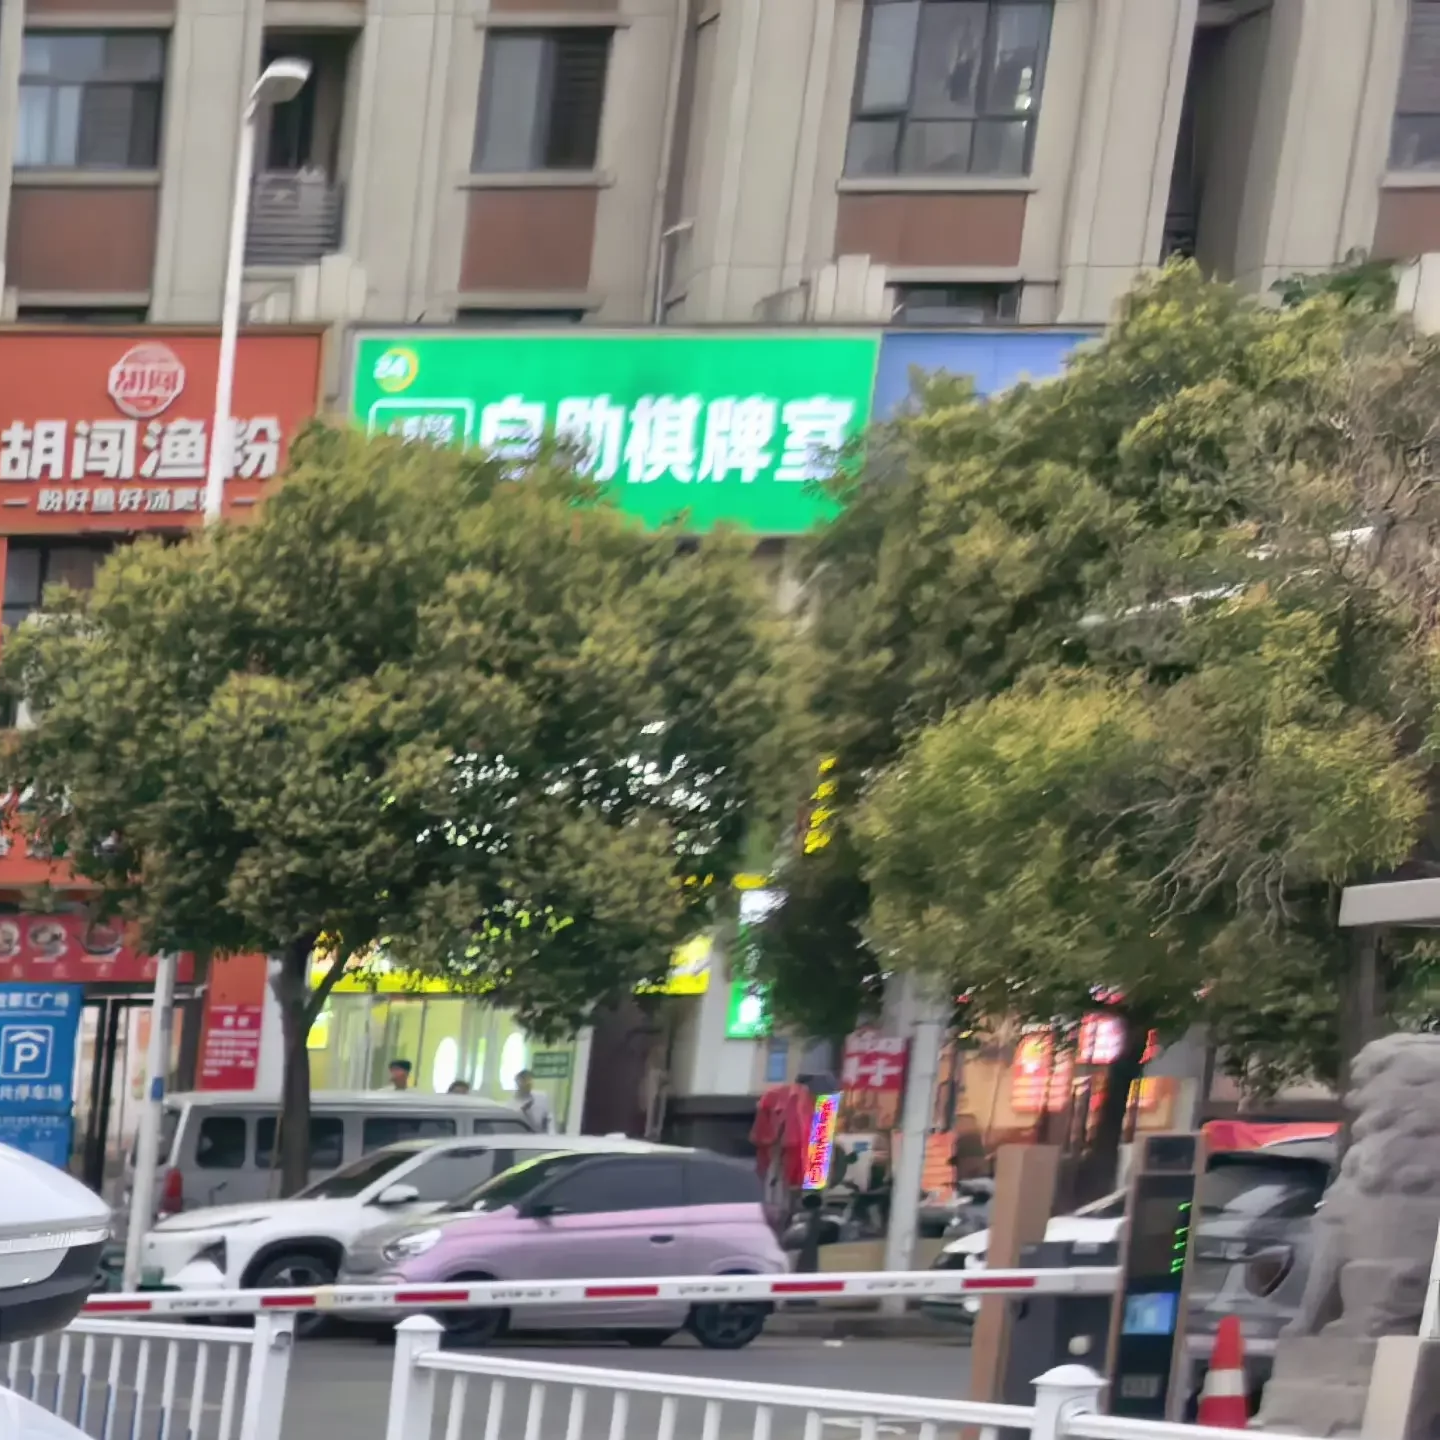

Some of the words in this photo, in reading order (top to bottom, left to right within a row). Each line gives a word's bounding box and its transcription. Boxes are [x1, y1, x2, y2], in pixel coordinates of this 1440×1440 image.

[0, 417, 281, 480] 胡闯渔粉
[482, 394, 854, 482] 自助棋牌室
[14, 1043, 40, 1072] P
